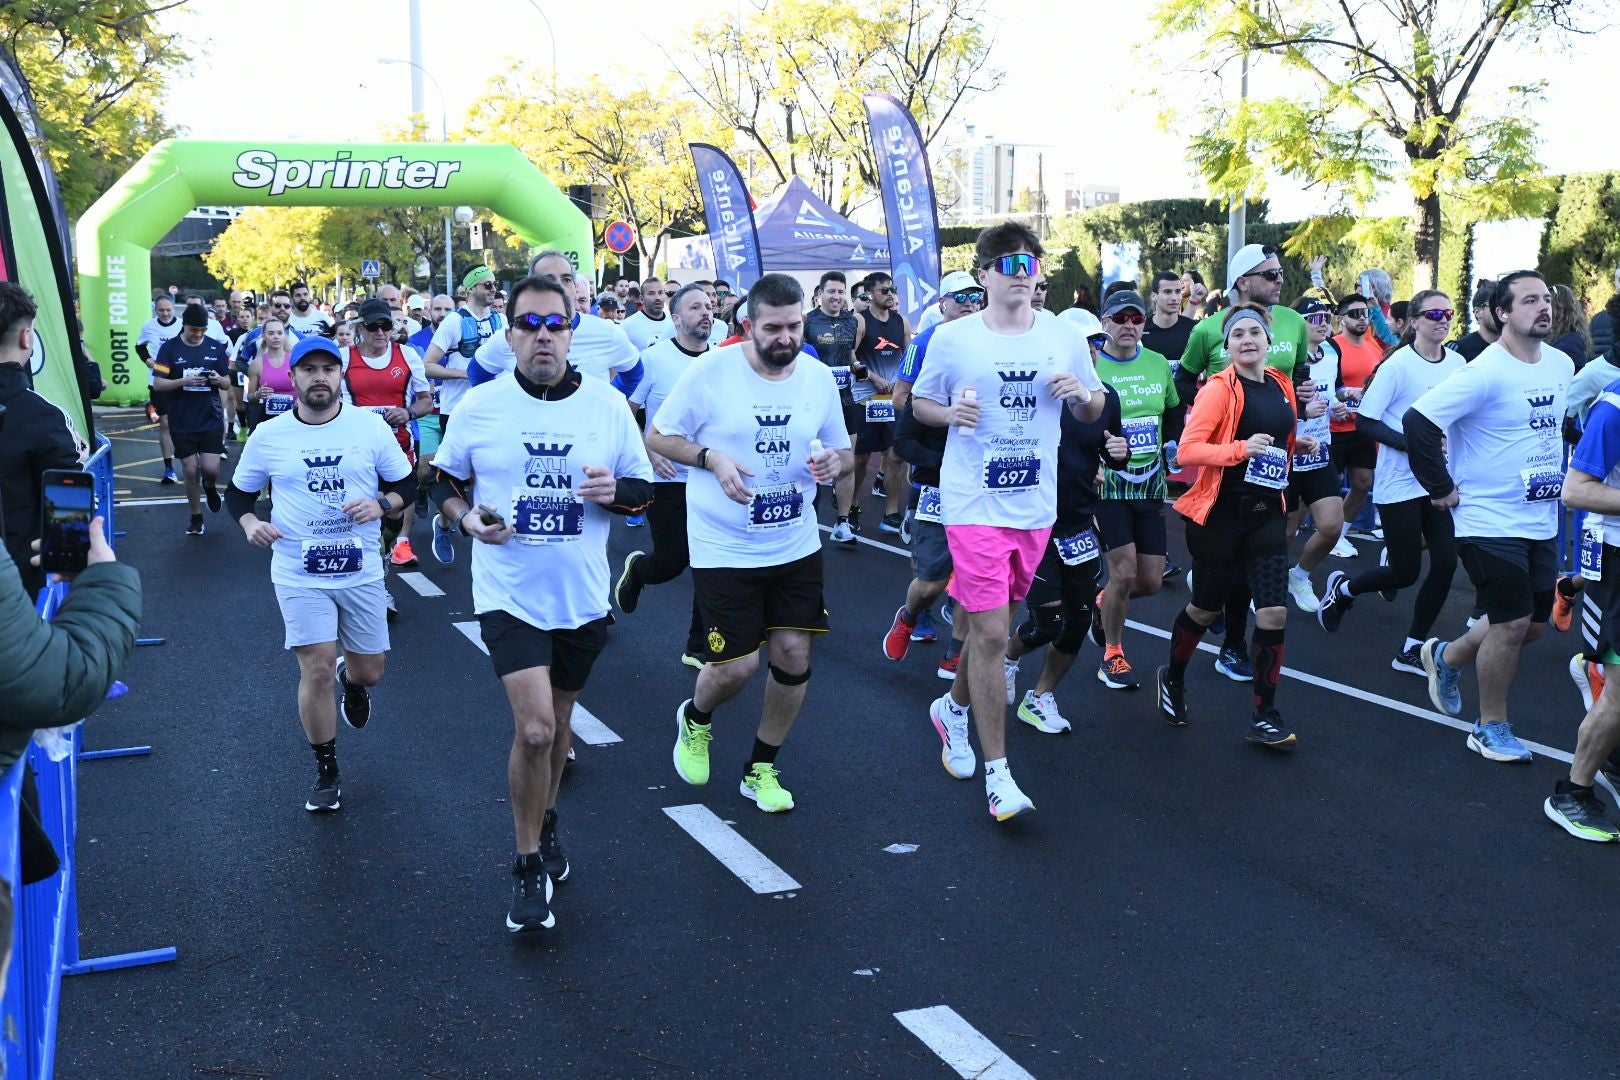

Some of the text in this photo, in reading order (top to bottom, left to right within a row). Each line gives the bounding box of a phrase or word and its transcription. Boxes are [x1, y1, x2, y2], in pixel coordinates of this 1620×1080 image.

[232, 149, 462, 196] Sprinter
[794, 231, 860, 241] Alicante
[106, 255, 130, 385] SPORT FOR LIFE
[1111, 375, 1146, 383] Runners
[1003, 382, 1033, 396] ALI
[1130, 383, 1162, 396] Top50
[272, 402, 288, 410] 397
[999, 396, 1037, 409] CAN
[1126, 398, 1142, 406] Club
[872, 409, 888, 417] 395
[1007, 409, 1029, 422] TE
[1529, 417, 1556, 430] CAN
[758, 427, 787, 441] ALI
[1129, 433, 1152, 446] 601
[755, 440, 791, 454] CAN
[1000, 438, 1031, 446] CONQUISTA
[529, 457, 567, 474] ALI
[762, 453, 784, 467] TE
[997, 461, 1031, 469] ALICANTE
[1301, 453, 1322, 465] 705
[310, 466, 341, 481] ALI
[997, 469, 1029, 485] 697
[1258, 462, 1284, 479] 307
[307, 478, 345, 493] CAN
[526, 474, 572, 490] CAN
[316, 490, 340, 504] TE
[1535, 484, 1561, 498] 679
[519, 495, 577, 504] CASTILLOS
[761, 495, 793, 505] ALICANTE
[526, 502, 569, 511] ALICANTE
[762, 504, 792, 521] 698
[306, 519, 314, 527] LA
[315, 517, 347, 527] CONQUISTA
[528, 513, 565, 532] 561
[577, 515, 585, 532] 10K
[312, 525, 353, 535] LOS CASTILLOS
[309, 543, 356, 551] CASTILLOS
[1069, 536, 1094, 555] 305
[316, 557, 349, 571] 347
